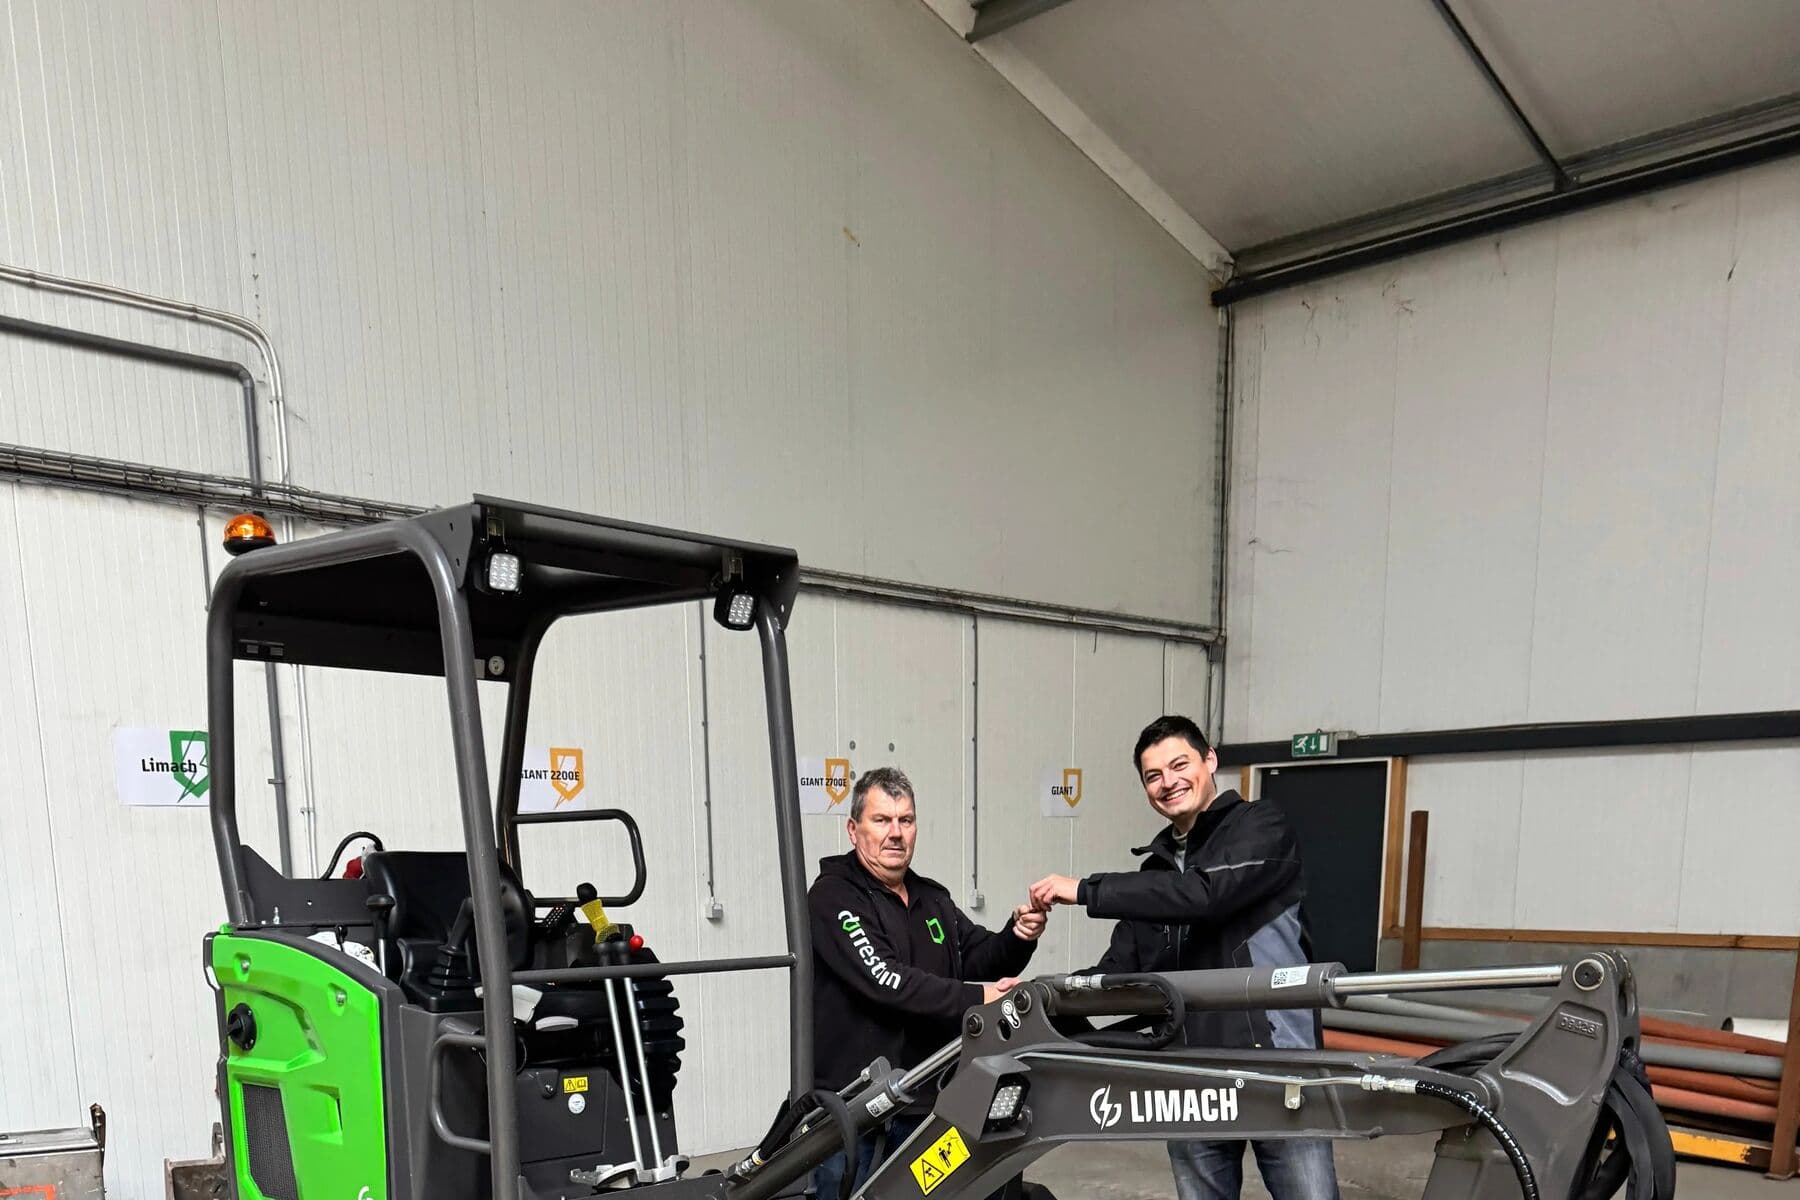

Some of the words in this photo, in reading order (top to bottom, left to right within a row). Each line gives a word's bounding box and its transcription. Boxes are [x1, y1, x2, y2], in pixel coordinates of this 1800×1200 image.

[141, 757, 198, 773] Limach
[550, 770, 580, 781] 2200E
[800, 777, 824, 787] GIANT
[825, 777, 847, 787] 2700E
[1051, 785, 1073, 796] GIANT
